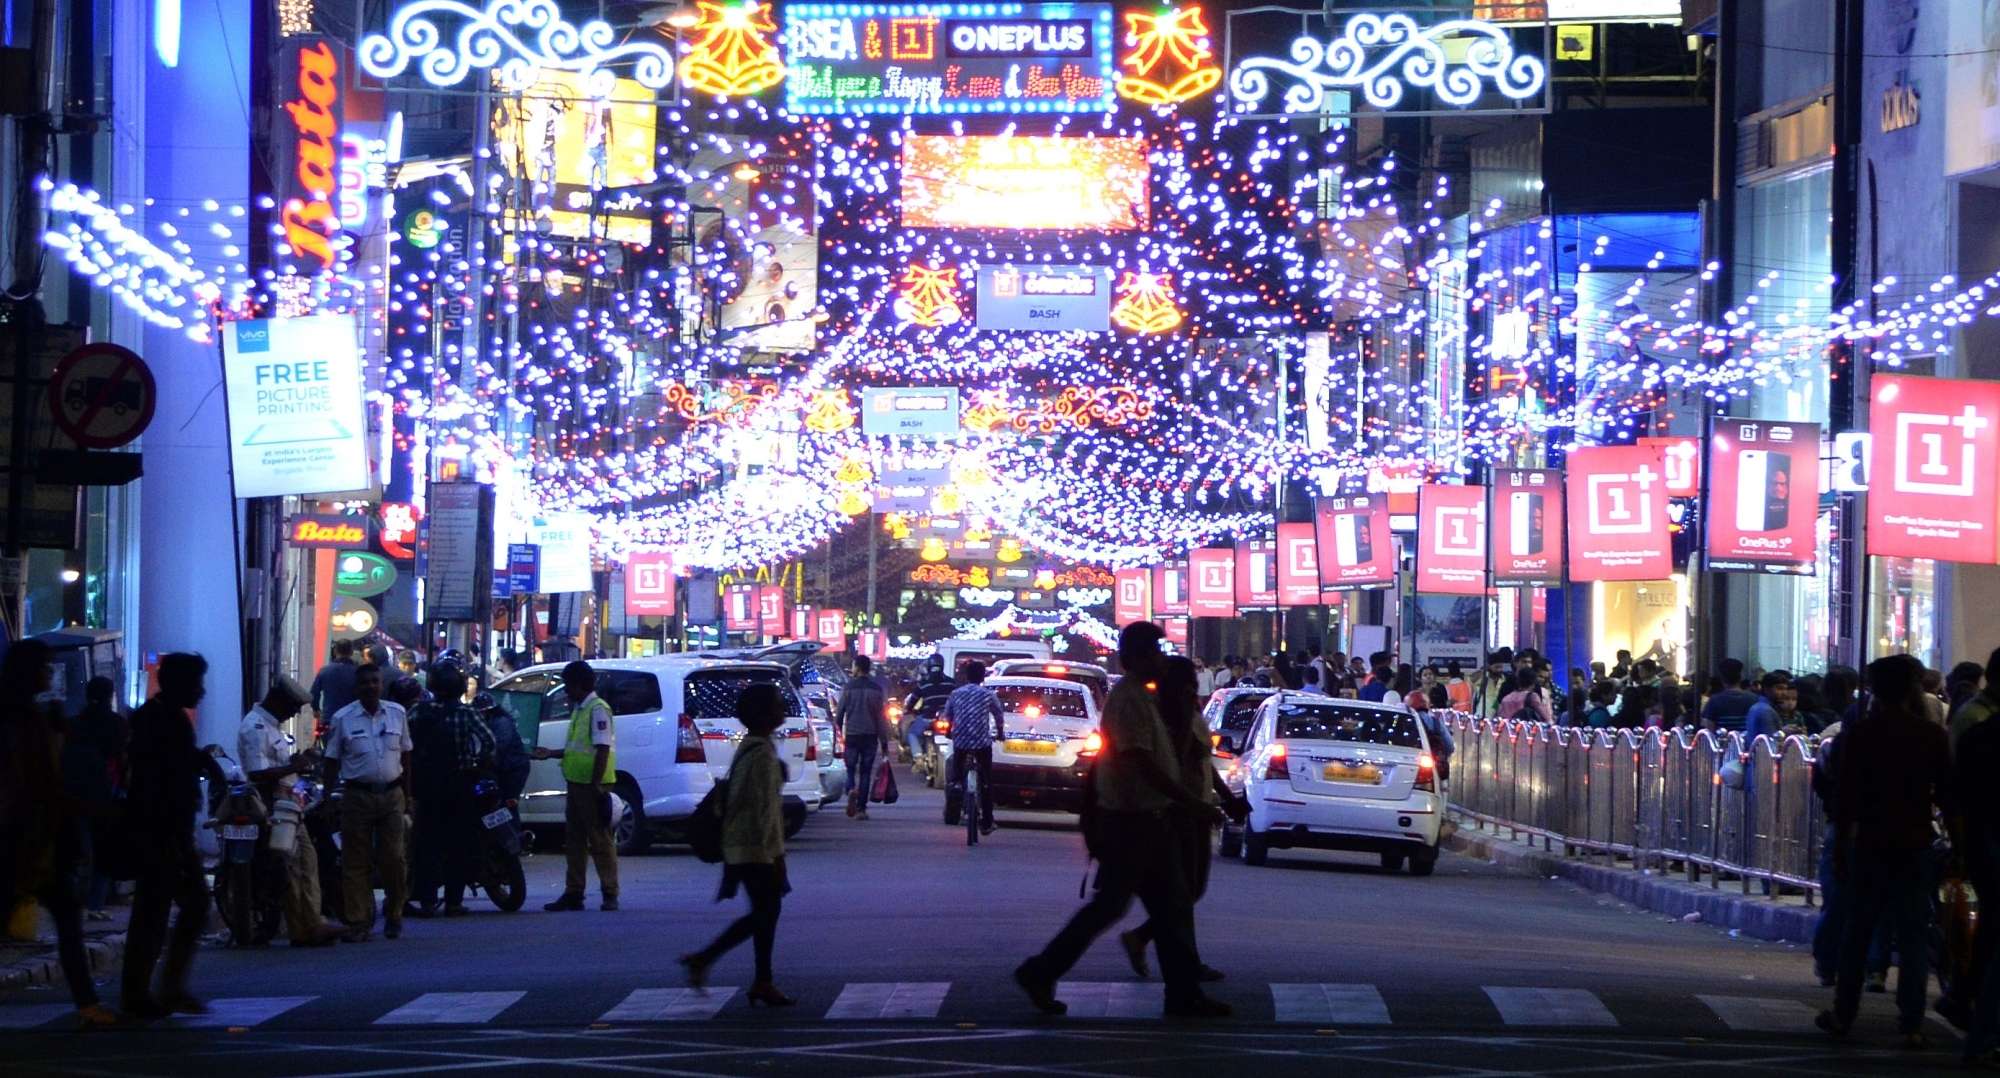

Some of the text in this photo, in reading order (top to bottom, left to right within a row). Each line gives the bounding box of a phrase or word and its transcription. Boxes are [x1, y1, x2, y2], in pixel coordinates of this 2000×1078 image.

[952, 25, 1085, 52] ONEPLUS
[282, 42, 337, 269] Bata
[1029, 310, 1061, 319] DASH
[255, 360, 329, 385] FREE
[256, 386, 331, 403] PICTURE
[257, 402, 333, 416] PRINTING
[295, 521, 365, 543] Bata
